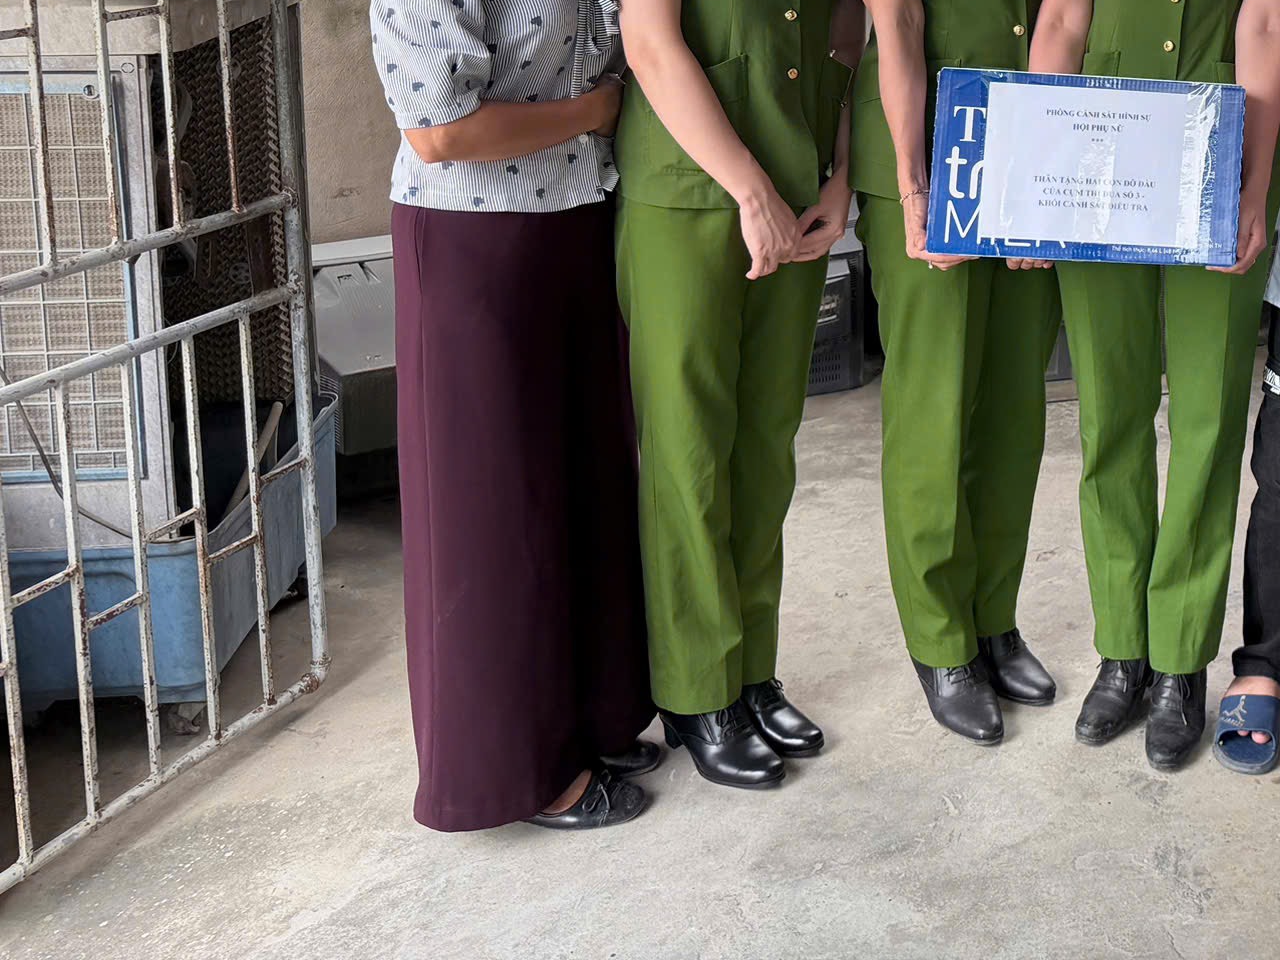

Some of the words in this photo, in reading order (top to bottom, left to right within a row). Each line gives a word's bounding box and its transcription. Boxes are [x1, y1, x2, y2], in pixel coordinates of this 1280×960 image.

[1046, 108, 1075, 117] PHÒNG
[1077, 110, 1099, 118] CẢNH
[1101, 111, 1117, 119] SÁT
[1072, 123, 1089, 131] HỘI
[1091, 124, 1109, 133] PHỤ
